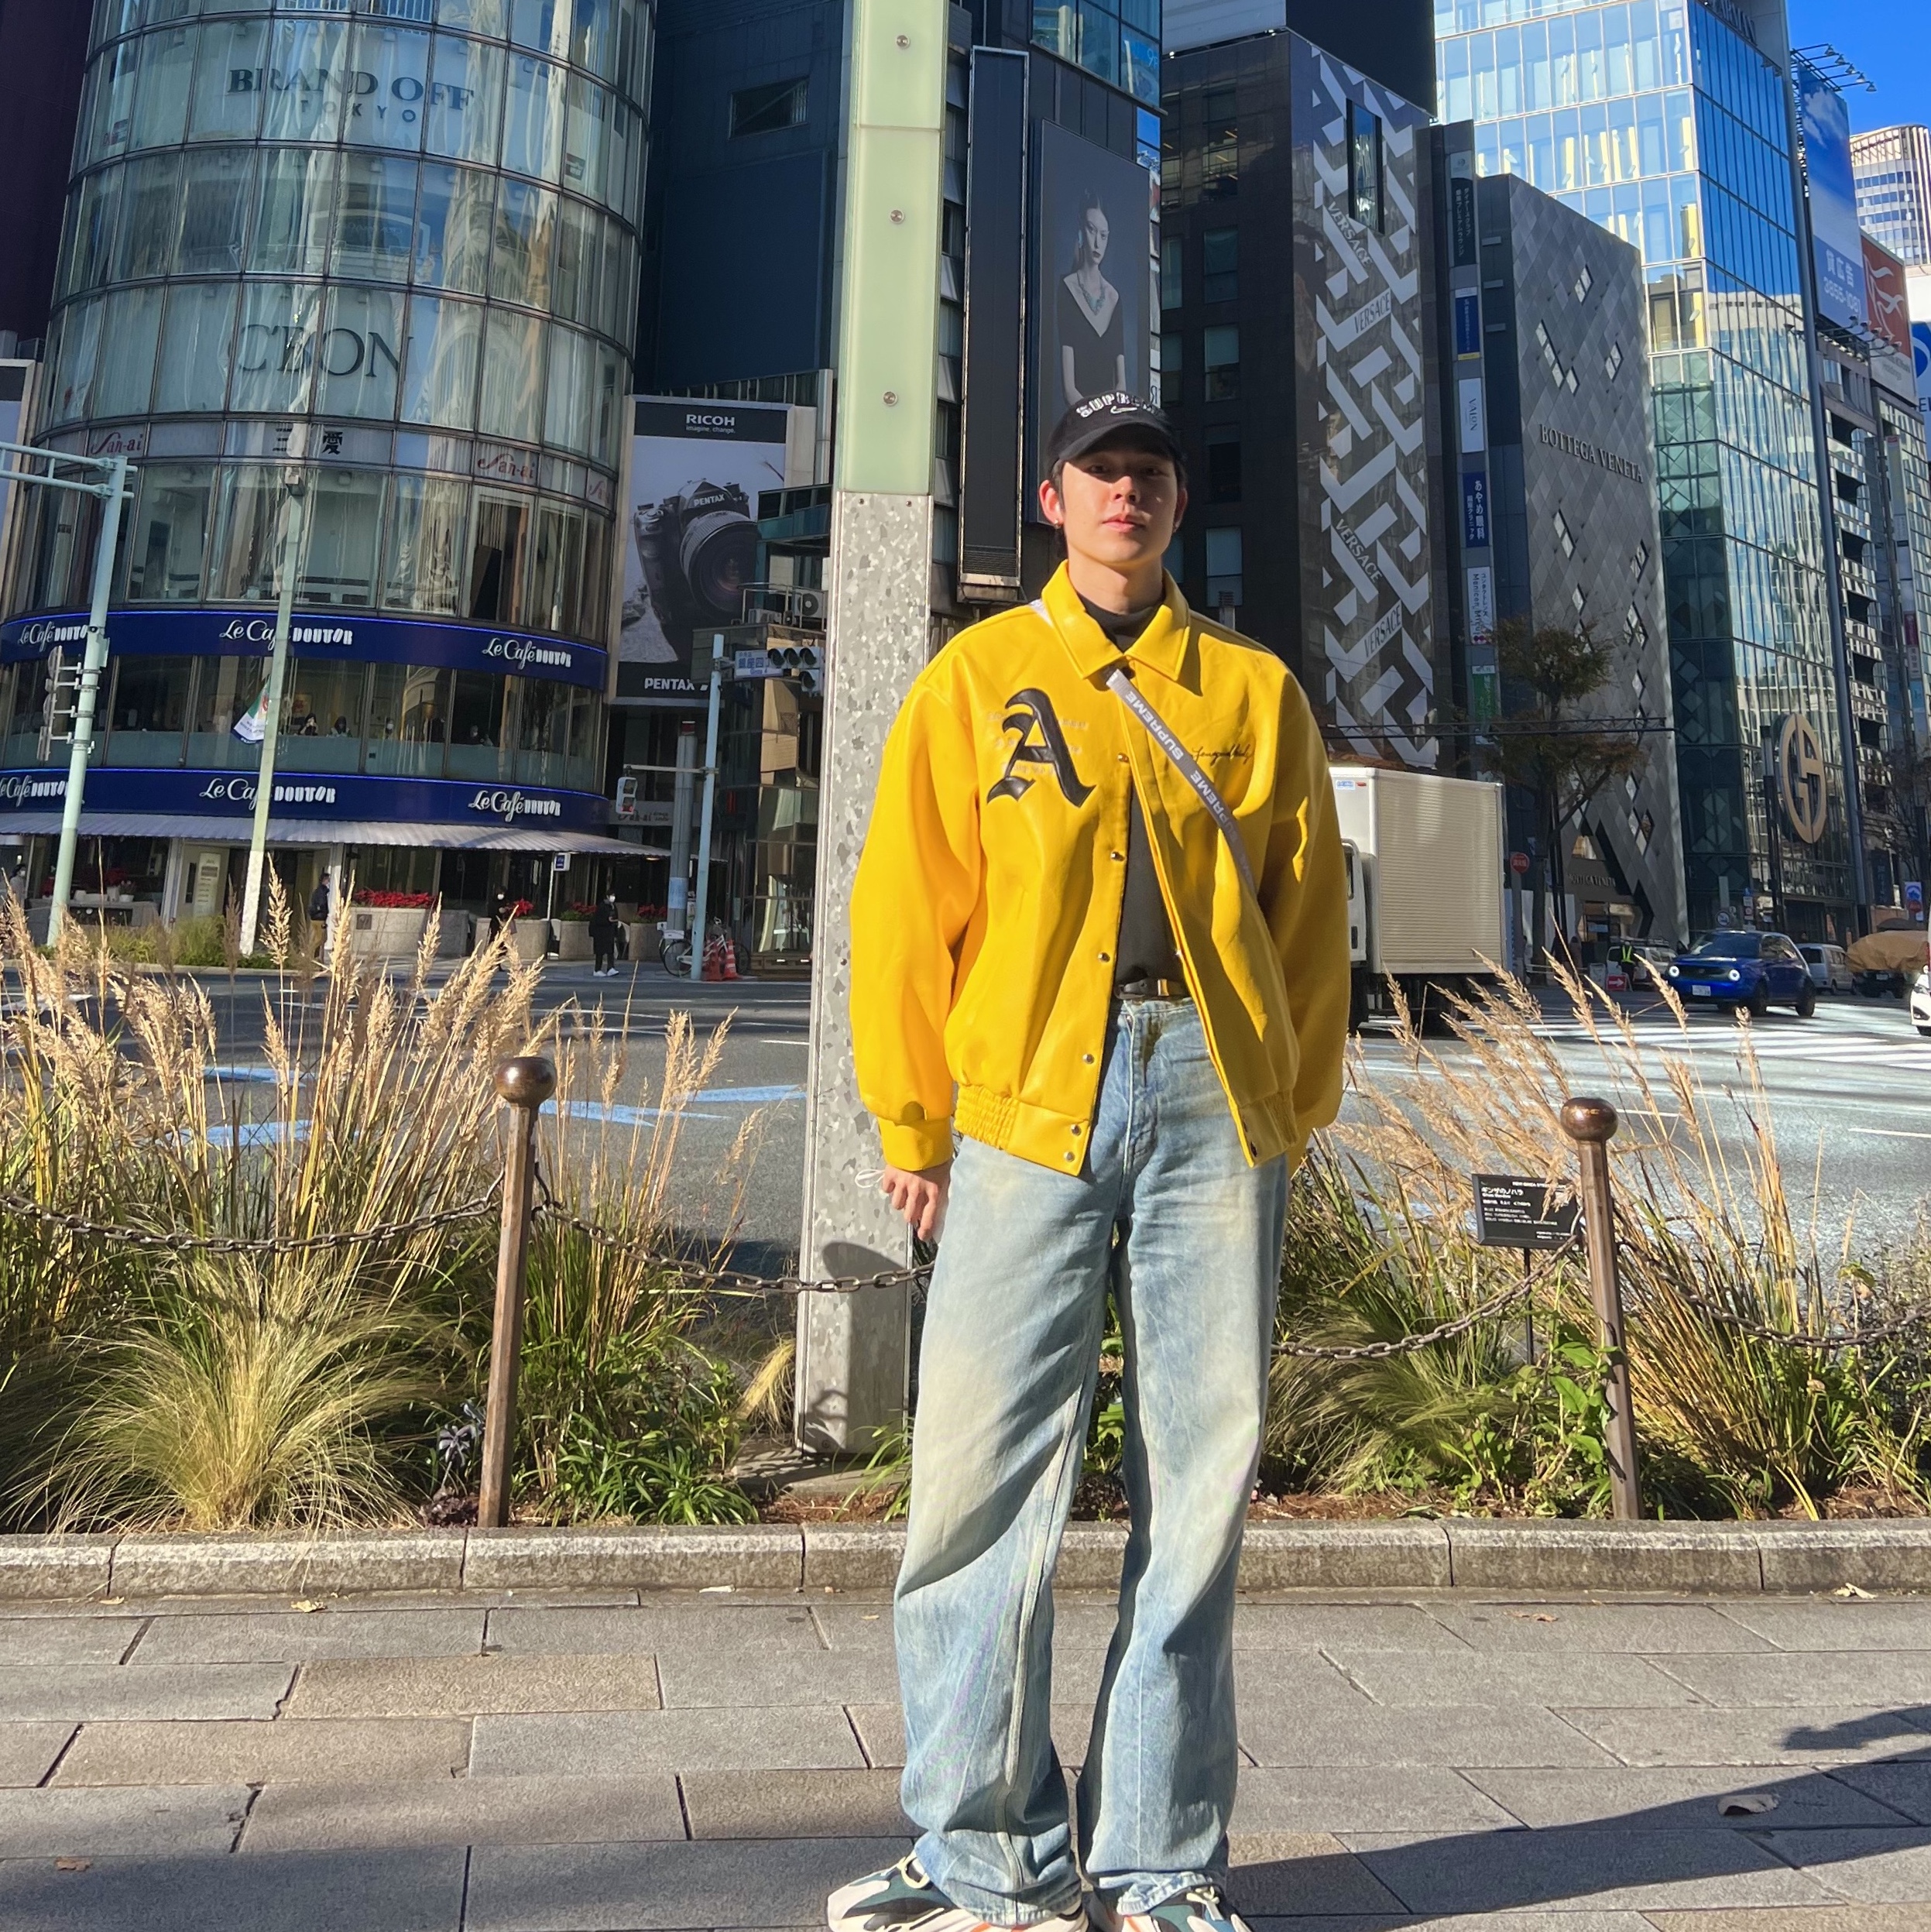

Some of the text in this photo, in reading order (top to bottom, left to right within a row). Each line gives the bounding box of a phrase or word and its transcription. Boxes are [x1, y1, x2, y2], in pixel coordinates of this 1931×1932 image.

[225, 67, 475, 111] BRAND OFF
[300, 98, 417, 123] TOKYO
[1328, 201, 1374, 266] VERSACE
[1354, 292, 1391, 335] VERSACE
[686, 414, 736, 427] RICOH
[1075, 391, 1161, 418] SUPREM
[91, 431, 143, 455] San-ai
[1540, 424, 1644, 483] BOTTEGA VENETA
[477, 452, 535, 479] San-ai
[694, 494, 725, 506] PENTAX
[1336, 518, 1383, 583] VERSACE
[18, 621, 87, 652] Le Café DOUTO
[219, 619, 245, 640] Le
[293, 627, 353, 645] DOUTOR
[1363, 605, 1402, 658] VERSACE
[482, 637, 571, 670] Le Café DOUTOR
[644, 678, 695, 690] PENTAX
[1125, 691, 1184, 760] SUPREME
[987, 688, 1097, 808] A
[6, 774, 33, 807] Café
[199, 778, 225, 799] Le
[274, 786, 336, 803] DOUTOR
[468, 790, 561, 822] Le Café DOUTOR
[1190, 770, 1237, 841] SUPREME
